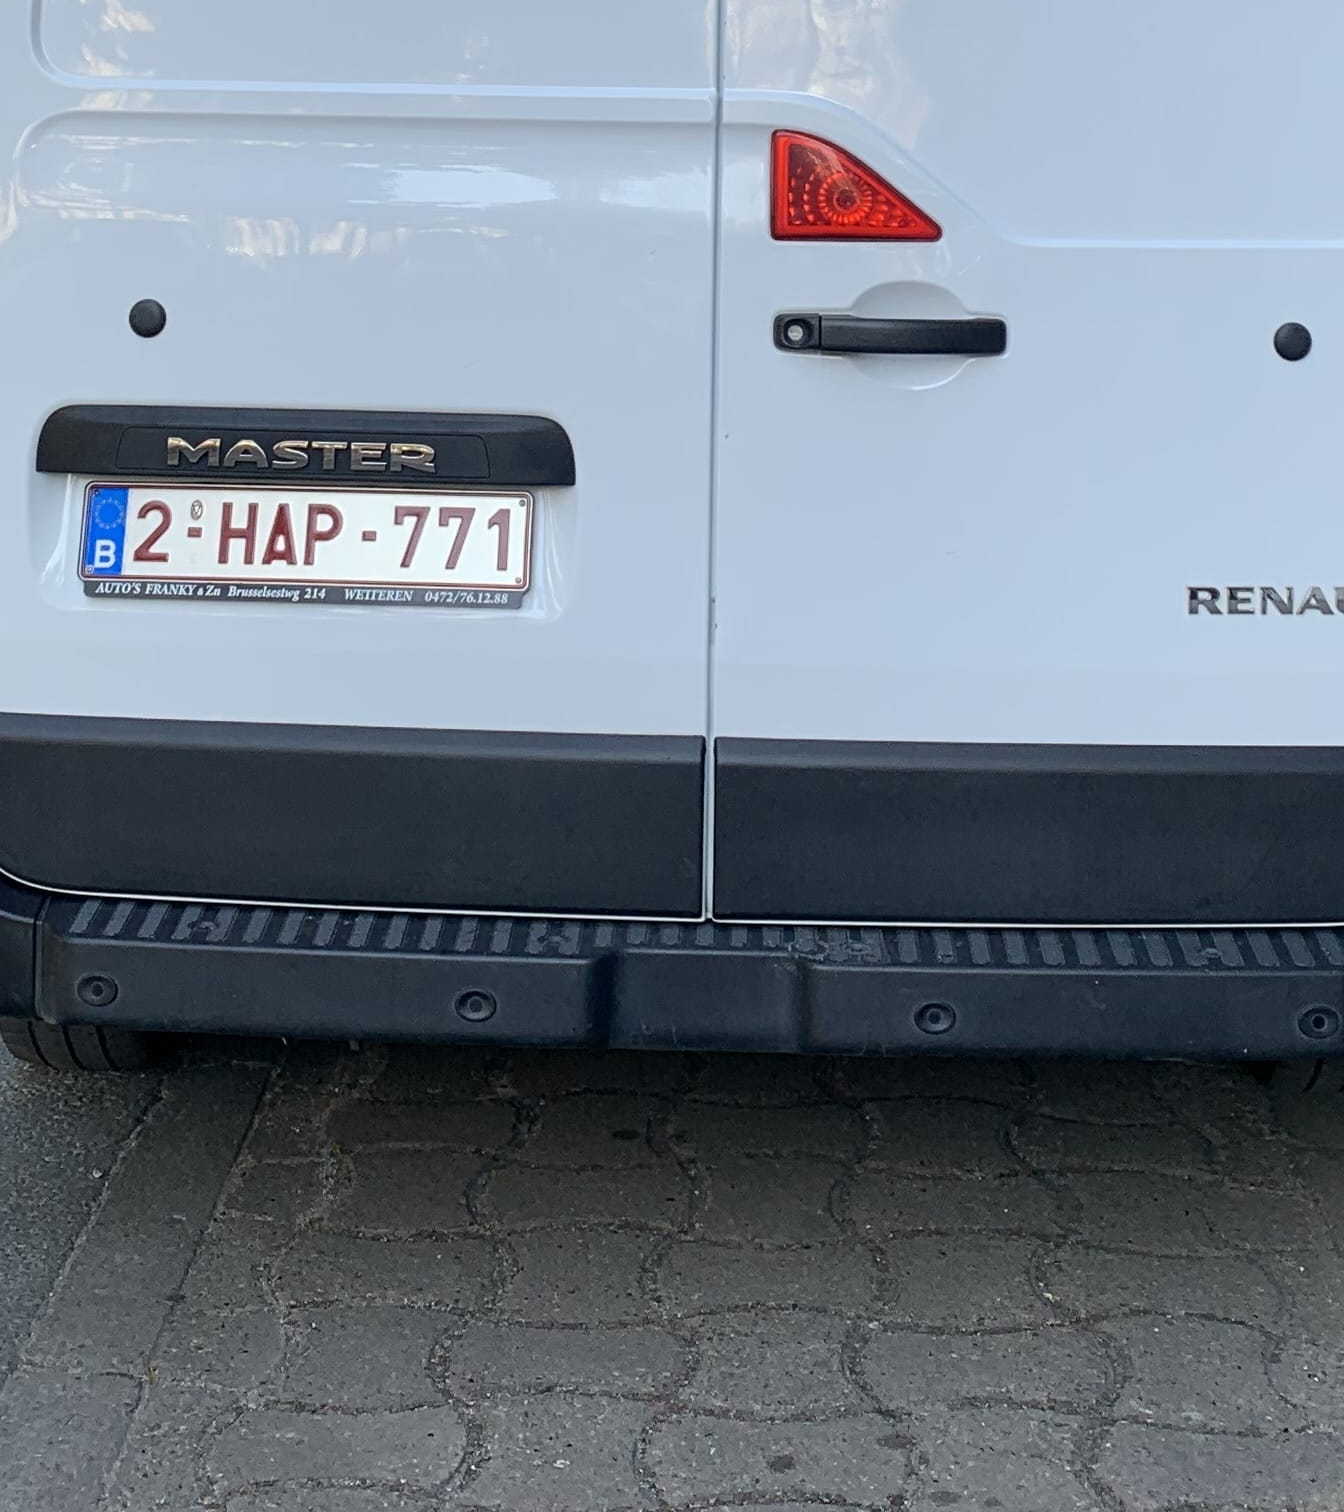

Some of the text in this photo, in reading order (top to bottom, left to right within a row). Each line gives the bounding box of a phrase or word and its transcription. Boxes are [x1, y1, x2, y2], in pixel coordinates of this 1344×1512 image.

[167, 437, 436, 473] MASTER
[132, 499, 512, 572] 2-HAP-771
[94, 539, 116, 569] B
[95, 583, 142, 594] AUTO'S
[145, 583, 197, 596] FRANKY
[227, 586, 301, 602] Brusselsestwg
[304, 588, 327, 599] 214
[344, 588, 415, 602] WETTEREN
[424, 591, 508, 605] 0472/76.12.88
